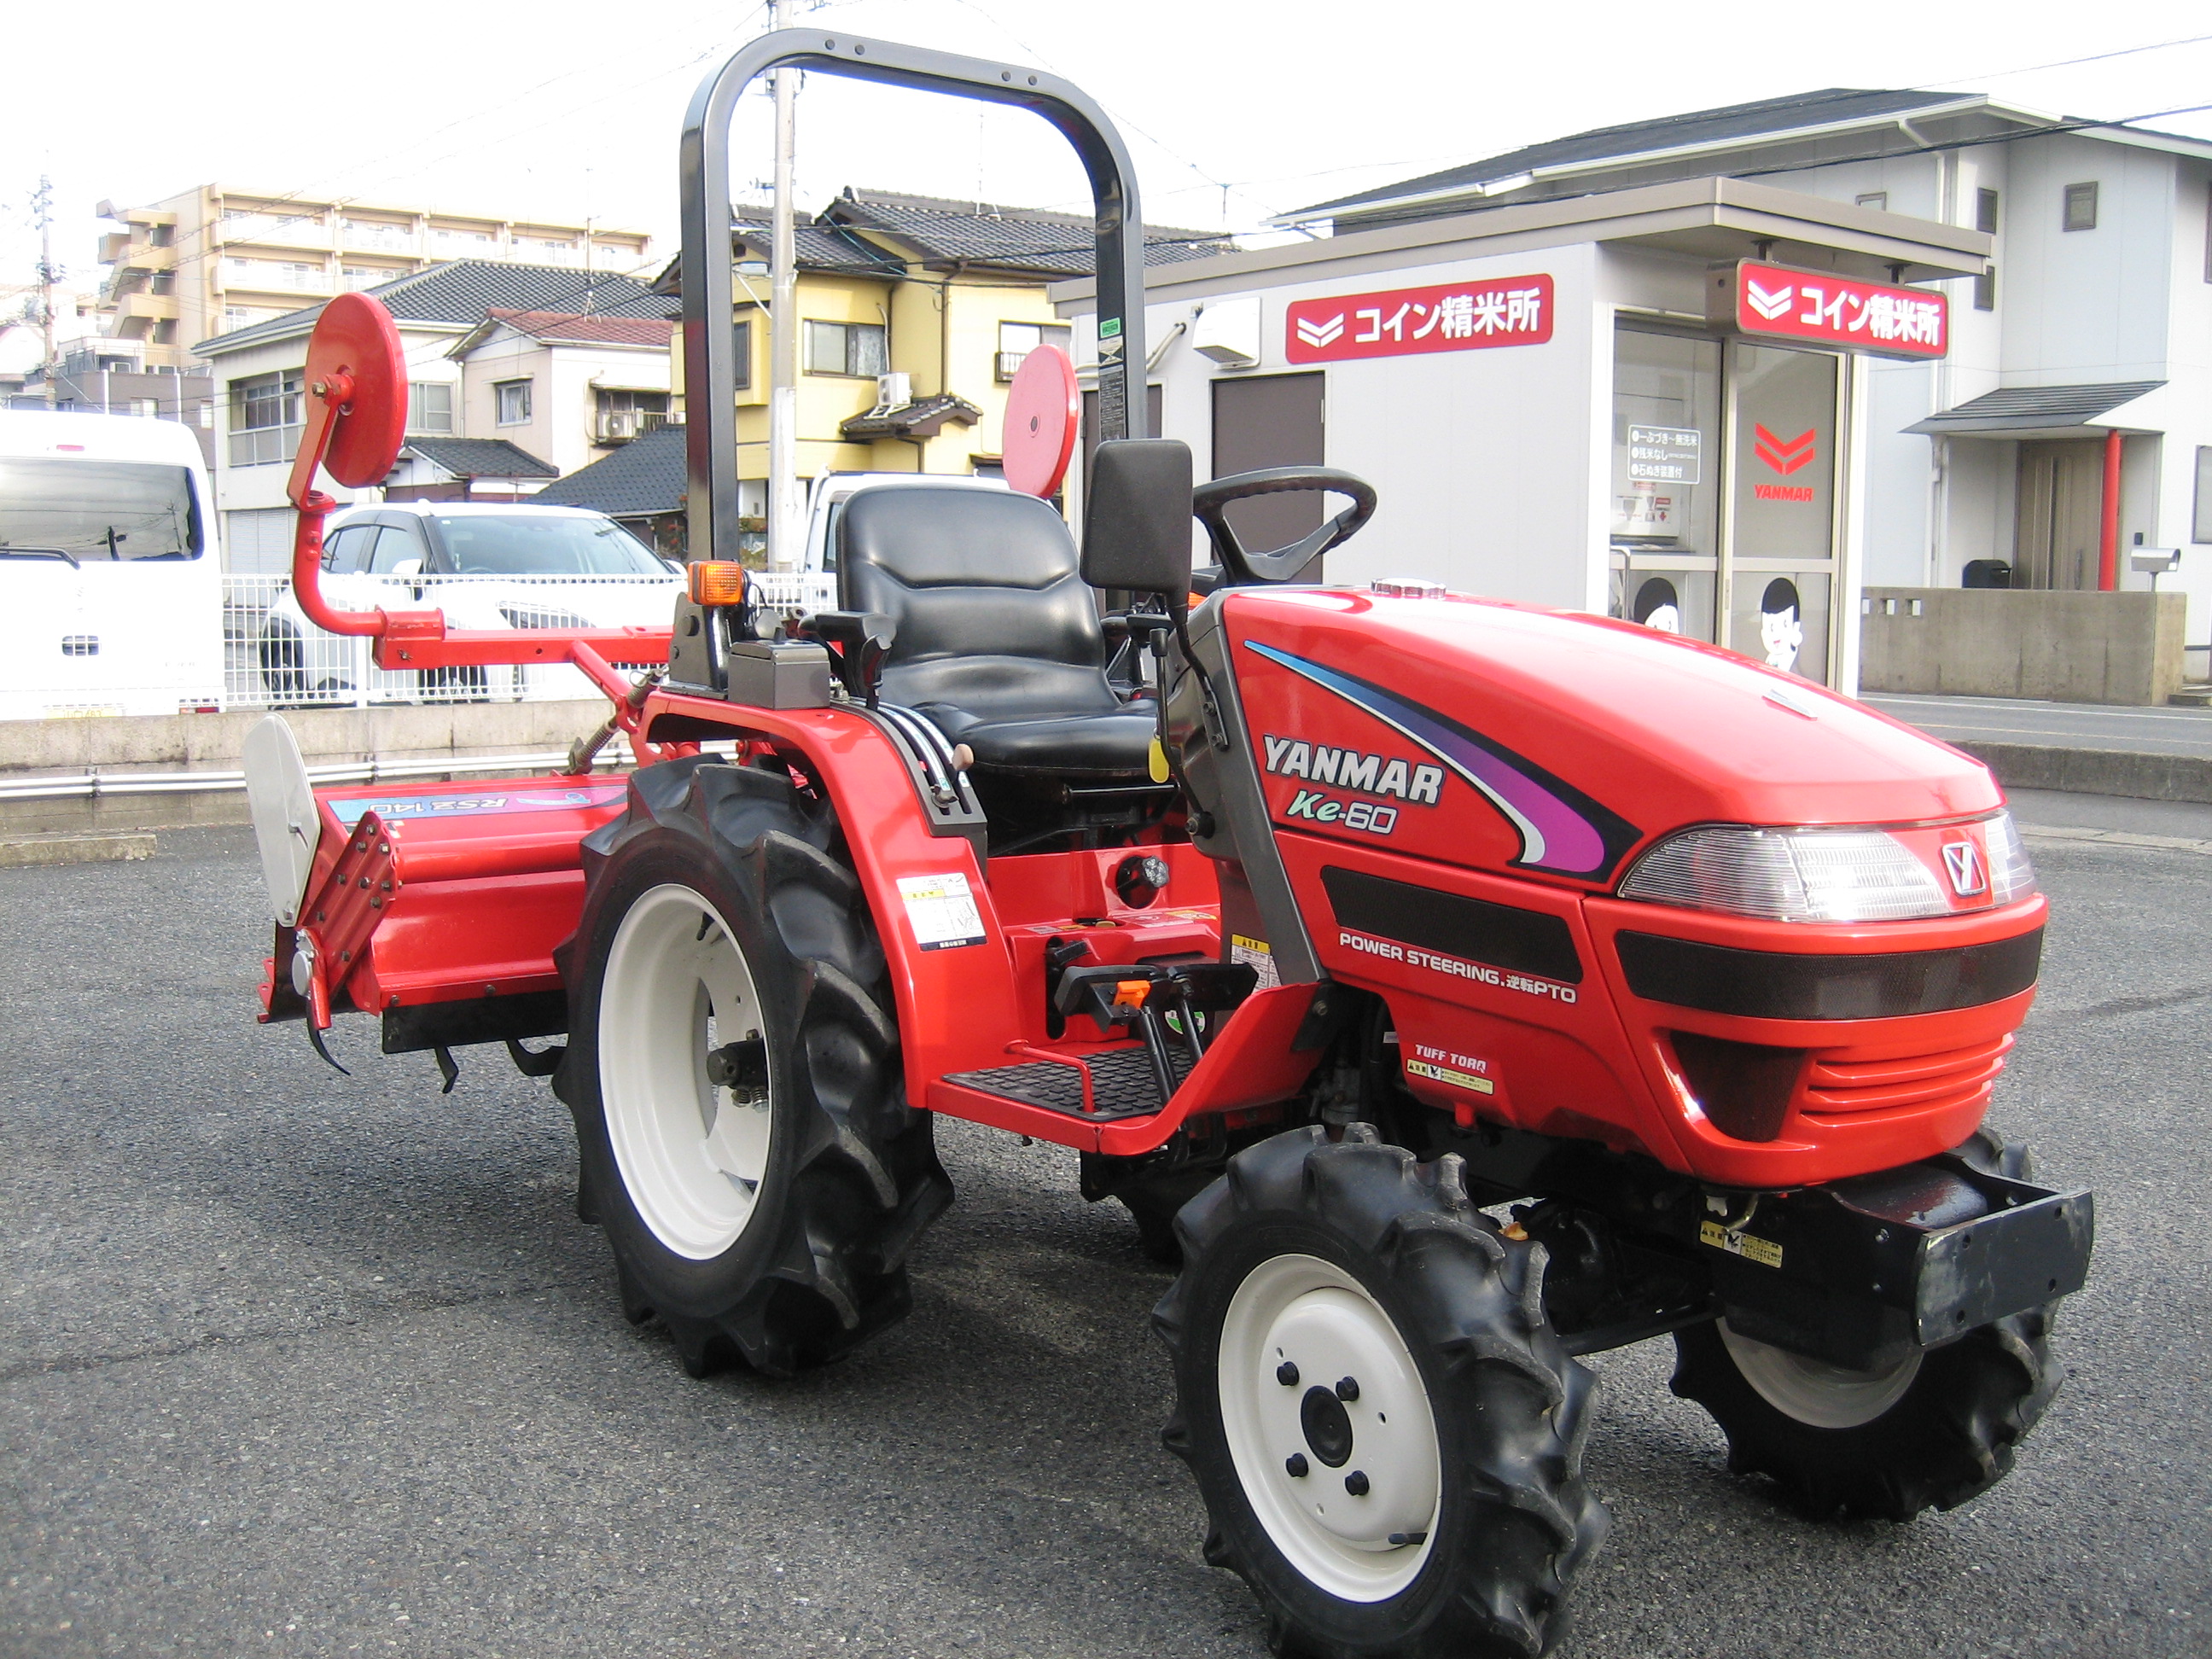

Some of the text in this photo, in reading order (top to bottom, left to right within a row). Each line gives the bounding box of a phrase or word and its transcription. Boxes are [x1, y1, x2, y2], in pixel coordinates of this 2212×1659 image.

[1354, 287, 1542, 343] コイン精米所
[1800, 287, 1941, 346] コイン精米所
[1754, 484, 1814, 502] YANMAR
[1263, 734, 1445, 805] YANMAR
[369, 802, 427, 814] 140
[1286, 789, 1398, 835] Ke-60
[1339, 932, 1403, 962] POWER
[1414, 1044, 1447, 1062] TUFF
[1450, 1051, 1487, 1074] TORQ
